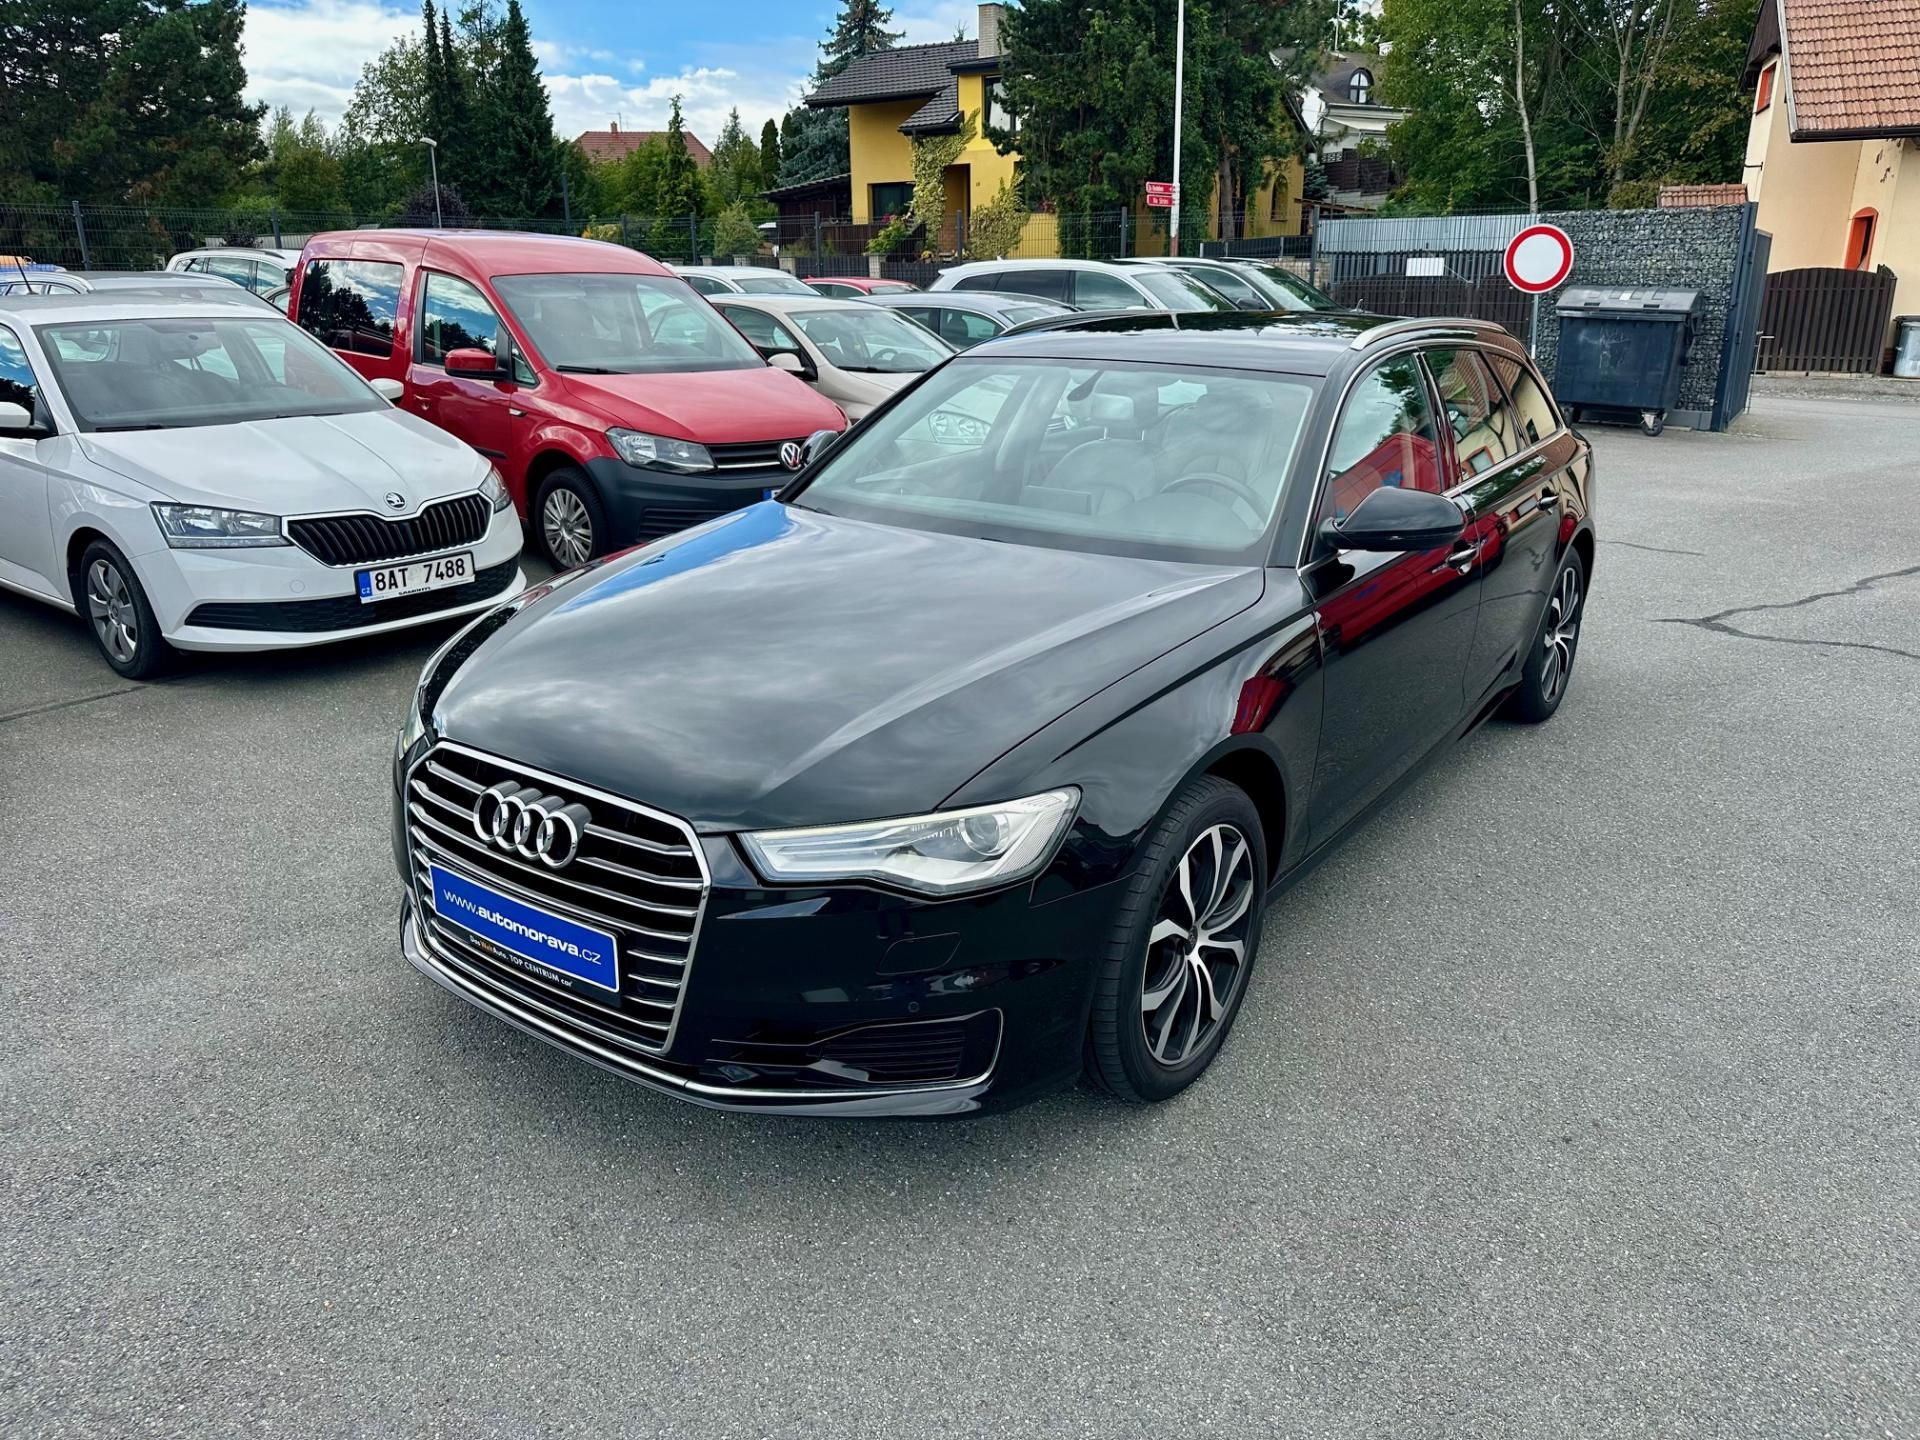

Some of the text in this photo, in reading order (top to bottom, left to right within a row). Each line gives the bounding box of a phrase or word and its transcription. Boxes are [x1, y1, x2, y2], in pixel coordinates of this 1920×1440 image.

[374, 558, 465, 591] 8AT 7488
[443, 889, 602, 965] www.automorava.cz
[509, 955, 523, 966] TOP
[524, 961, 560, 982] CENTRUM
